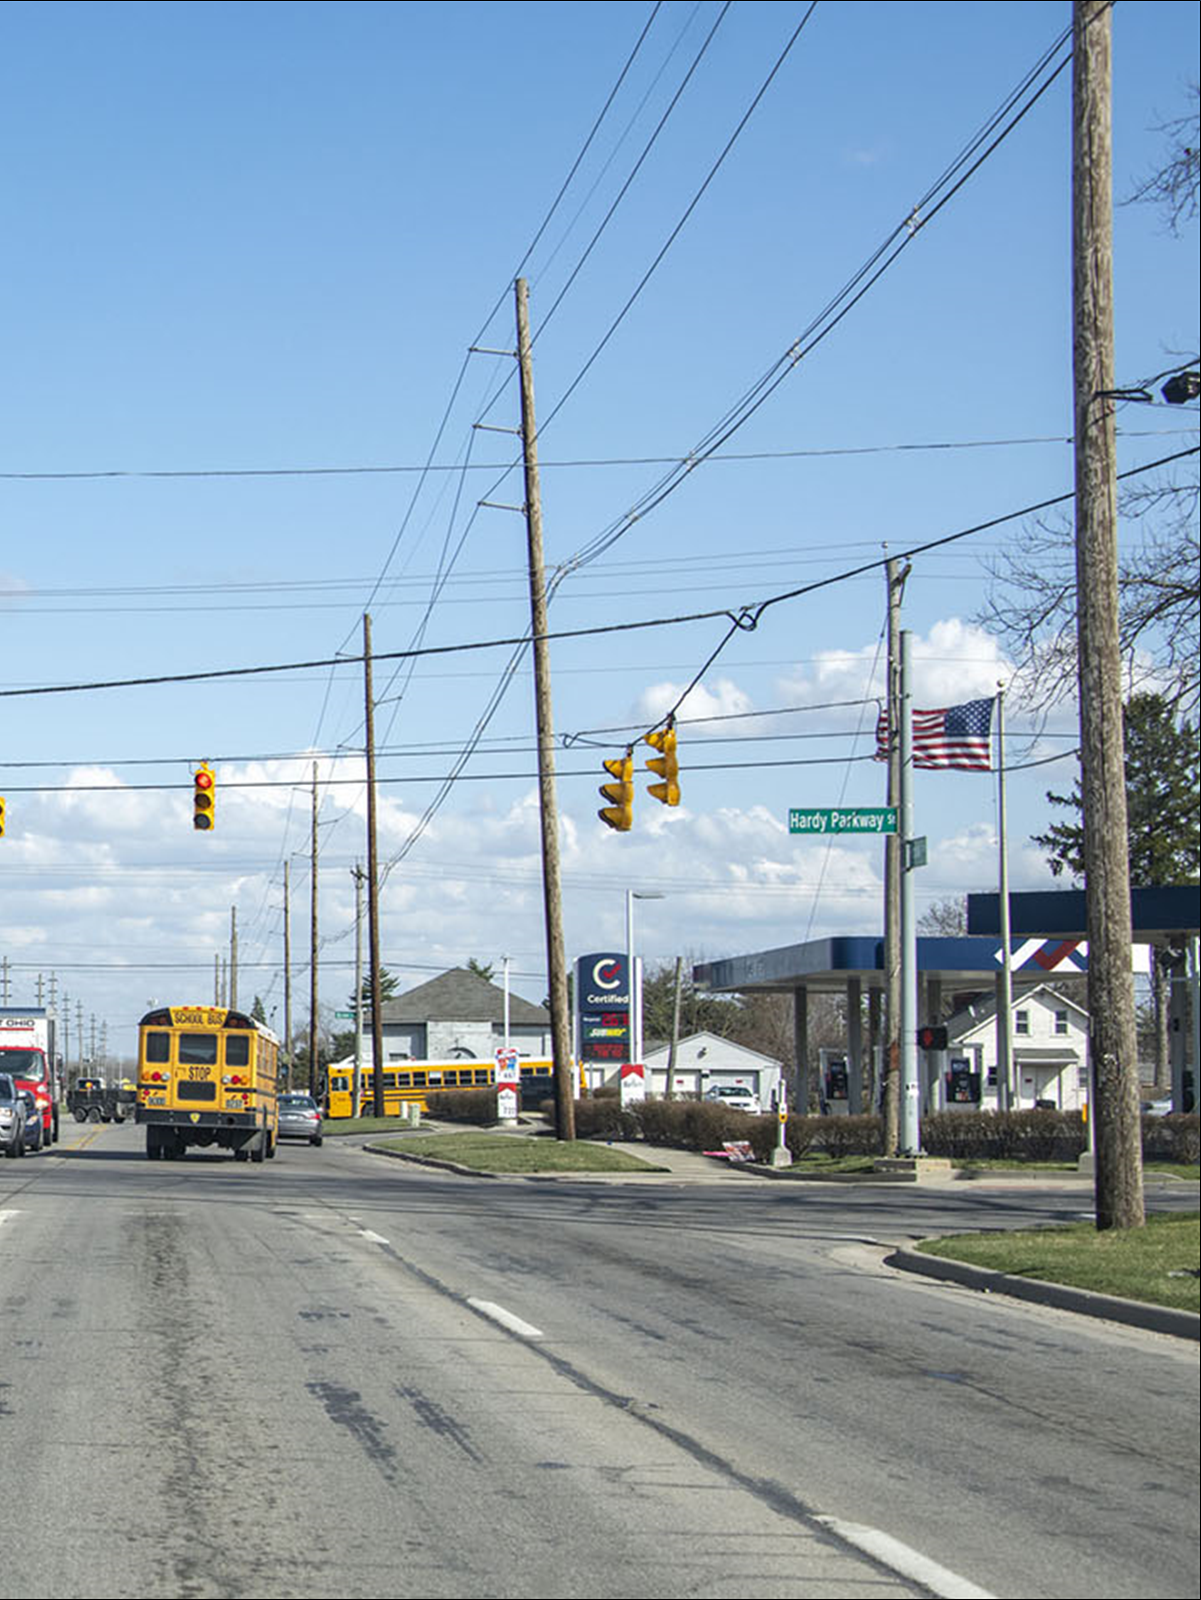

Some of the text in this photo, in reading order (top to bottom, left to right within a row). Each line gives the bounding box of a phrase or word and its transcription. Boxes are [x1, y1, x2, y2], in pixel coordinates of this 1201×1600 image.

[790, 812, 828, 832] Hardy
[831, 811, 884, 831] Parkway
[587, 994, 630, 1004] Certified
[5, 1019, 36, 1028] OHIO
[175, 1011, 224, 1026] SCHOOL BUS
[188, 1066, 212, 1081] STOP
